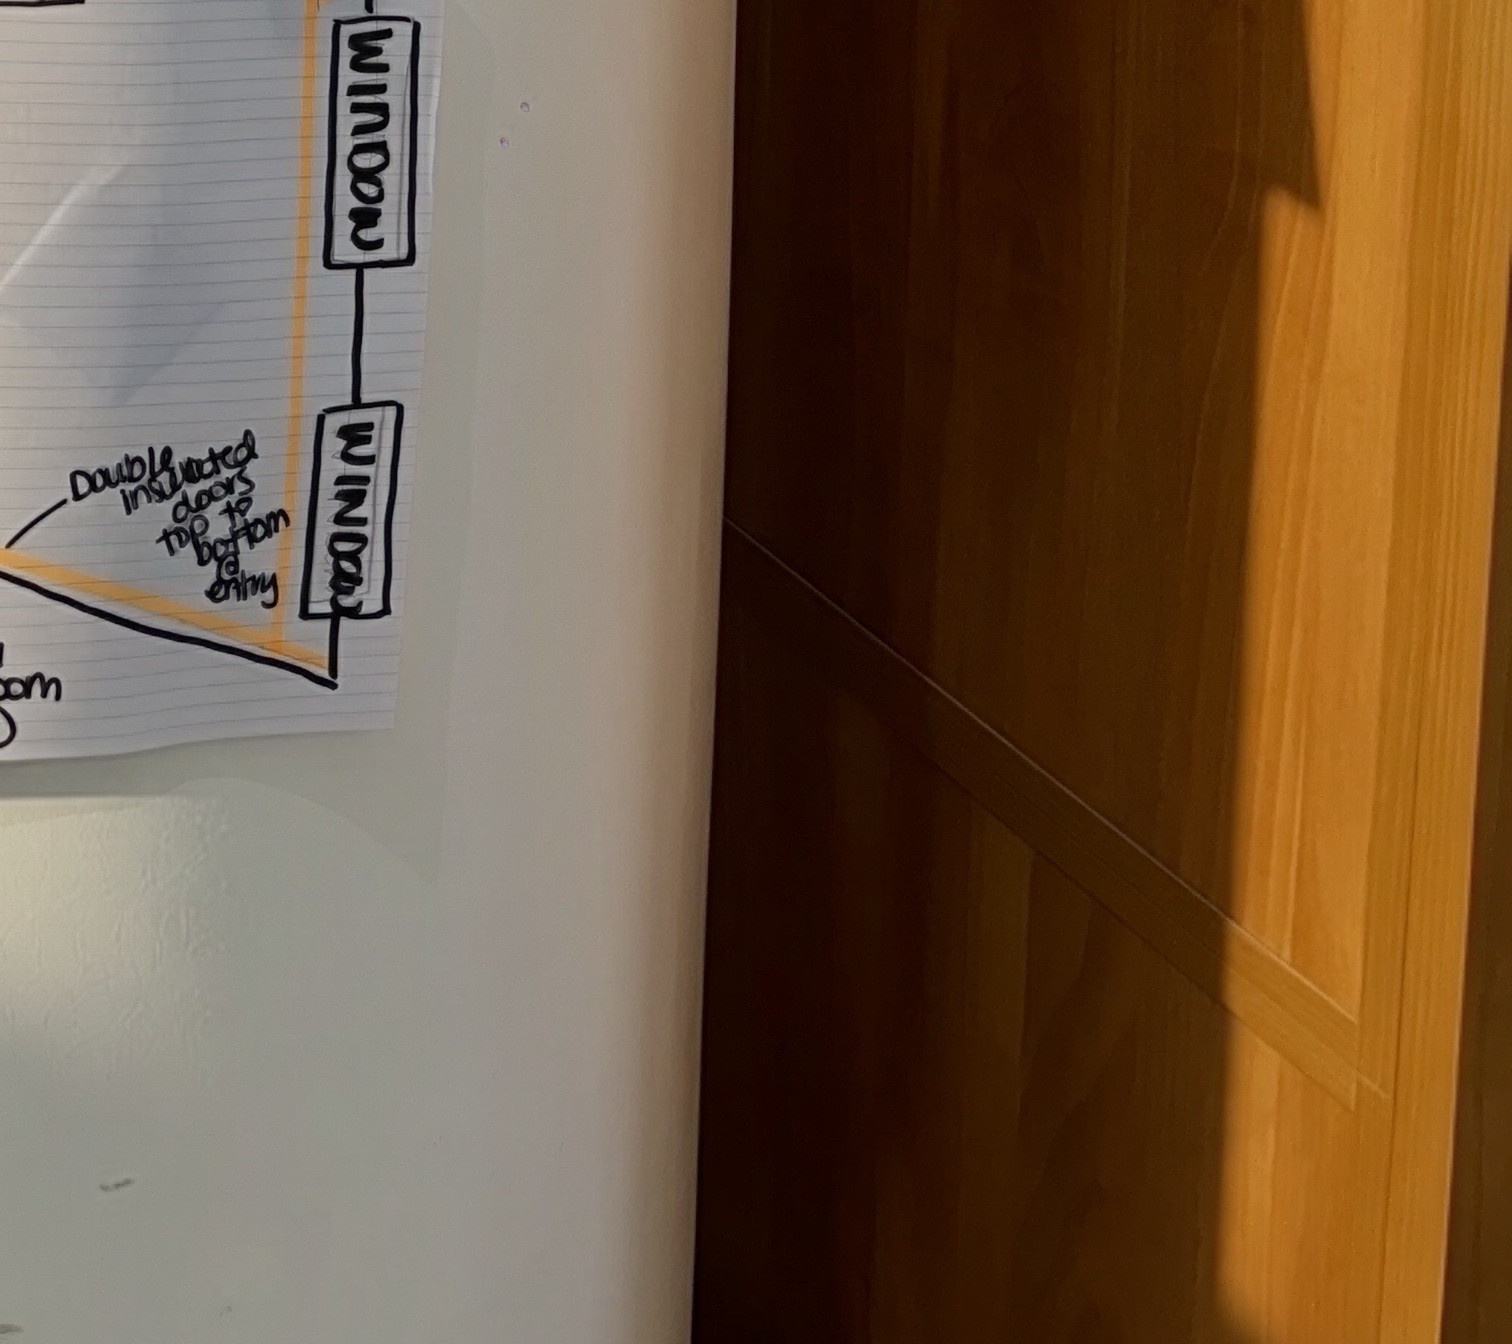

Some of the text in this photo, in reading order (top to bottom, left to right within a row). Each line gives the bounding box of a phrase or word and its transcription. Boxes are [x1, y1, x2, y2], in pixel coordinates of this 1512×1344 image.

[69, 446, 175, 502] Double
[172, 466, 255, 523] doors
[204, 569, 279, 609] entry
